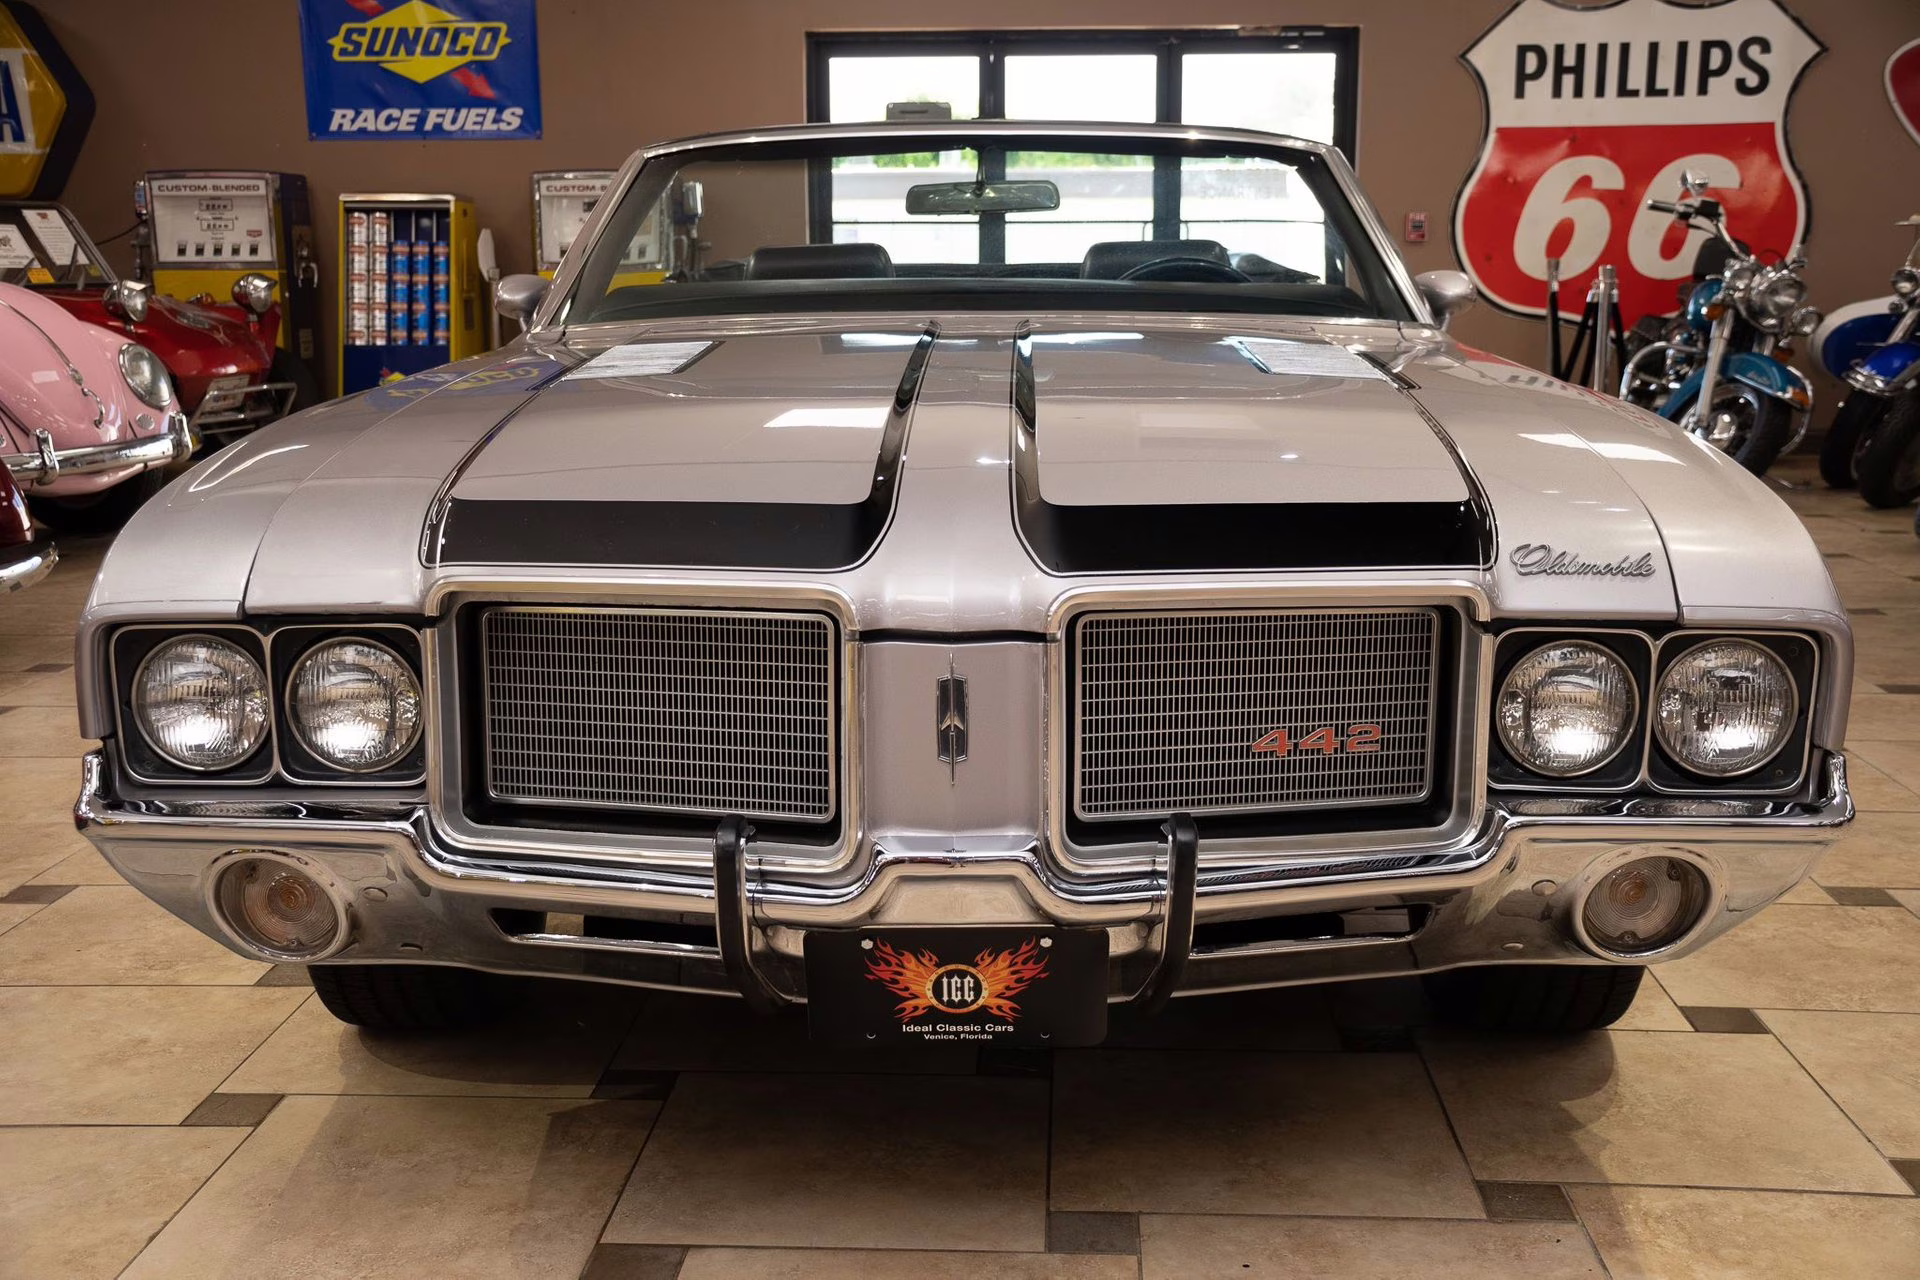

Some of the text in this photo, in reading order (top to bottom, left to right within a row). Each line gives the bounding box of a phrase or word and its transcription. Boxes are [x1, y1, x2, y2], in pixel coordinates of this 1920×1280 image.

[338, 26, 501, 58] SUNOCO
[1514, 36, 1772, 99] PHILLIPS
[329, 107, 524, 131] RACE FUELS
[1513, 153, 1741, 281] 66
[1510, 543, 1656, 577] Oldsmobile
[942, 973, 975, 1005] ICC
[902, 1023, 1014, 1032] Ideal Classic Cars
